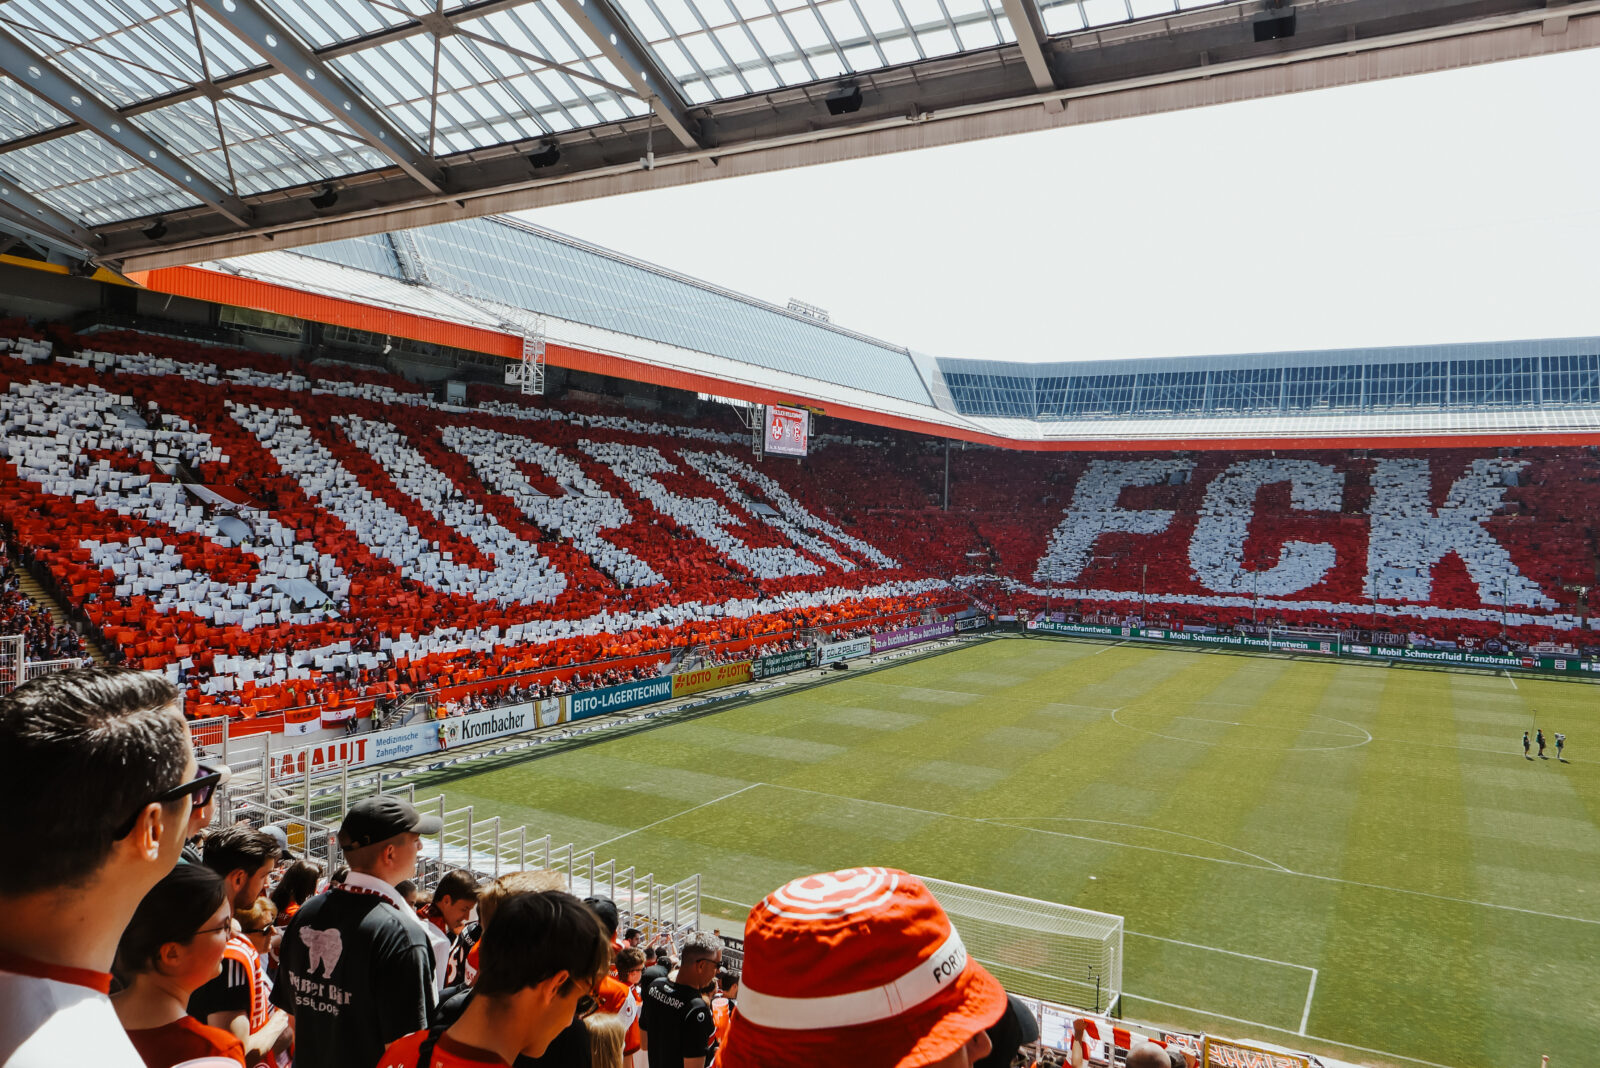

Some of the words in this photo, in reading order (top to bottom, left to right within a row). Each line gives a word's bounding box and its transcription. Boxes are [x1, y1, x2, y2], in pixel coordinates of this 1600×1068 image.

[1033, 458, 1559, 609] FCK
[1170, 631, 1190, 640] Mobil
[1193, 634, 1241, 645] Schmerzfluid
[1244, 637, 1308, 649] Franzbanntwein
[1378, 647, 1402, 657] Mobil
[1405, 650, 1462, 661] Schmerzfluid
[686, 671, 711, 686] LOTTO
[727, 663, 751, 678] LOTTO
[574, 681, 670, 714] BITO-LAGERTECHNIK
[462, 711, 525, 740] Krombacher
[376, 731, 418, 748] Medizinische
[376, 743, 413, 758] Zahnpflege
[649, 986, 685, 1009] DÜSSELDORF
